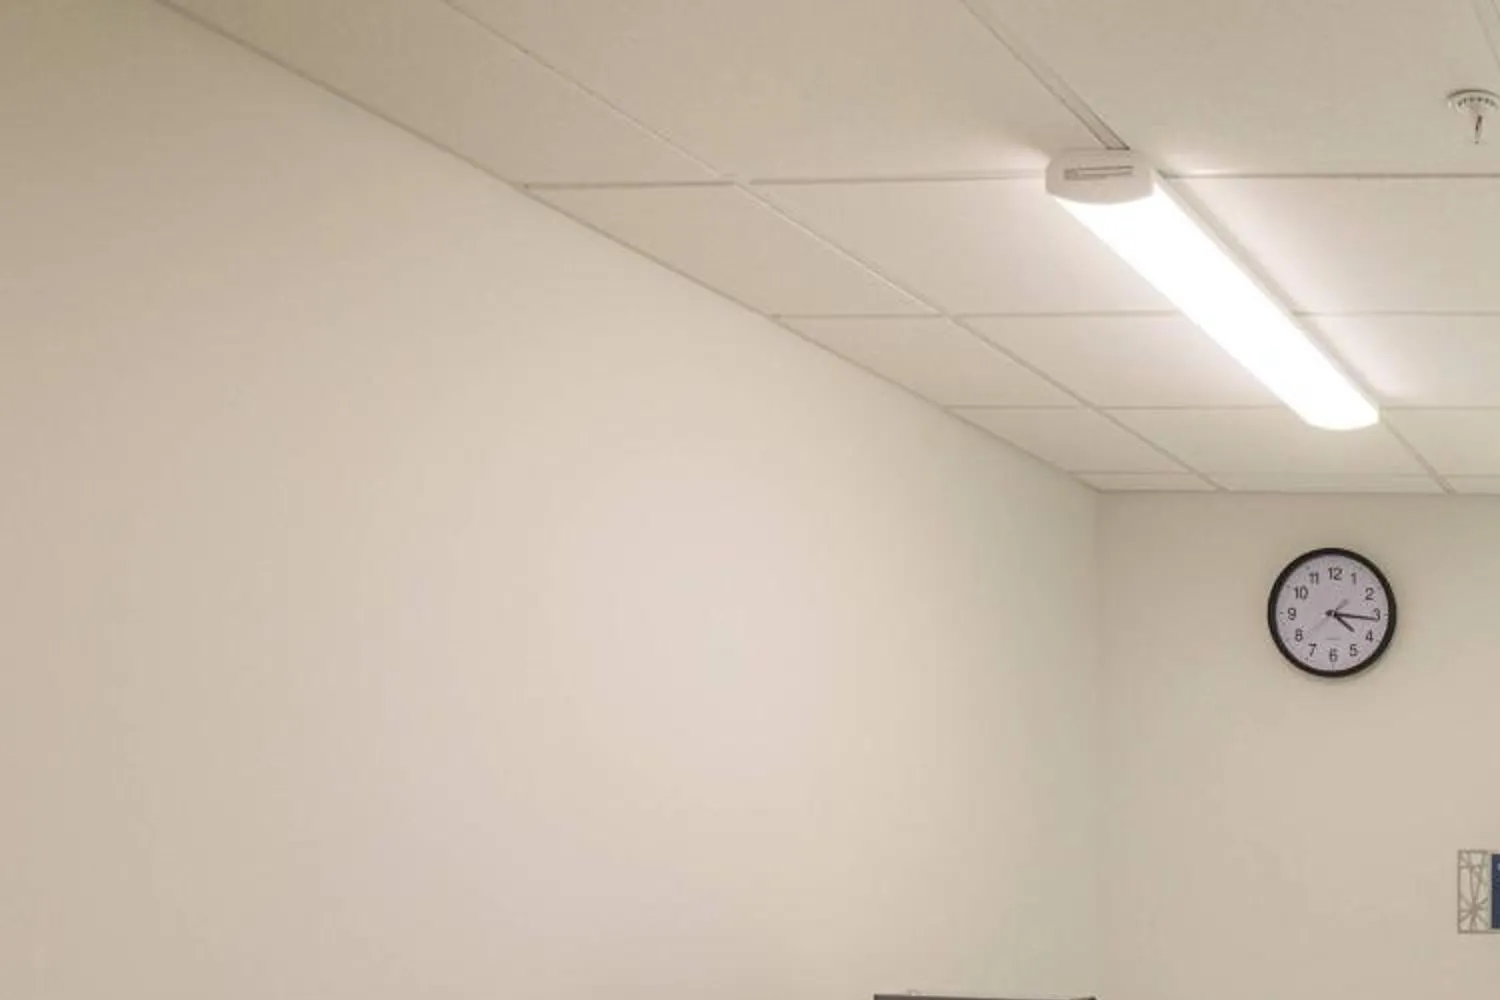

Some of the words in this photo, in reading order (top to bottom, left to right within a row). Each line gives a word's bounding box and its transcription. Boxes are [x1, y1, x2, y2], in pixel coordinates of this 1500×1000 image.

[1309, 572, 1319, 585] 11
[1328, 567, 1343, 581] 12
[1351, 572, 1357, 585] 1
[1294, 585, 1309, 600] 10
[1365, 587, 1375, 601] 2
[1287, 607, 1297, 621] 9
[1373, 608, 1381, 622] 3
[1295, 628, 1304, 642] 8
[1365, 629, 1374, 642] 4
[1308, 643, 1317, 657] 7
[1329, 648, 1338, 662] 6
[1349, 643, 1358, 657] 5
